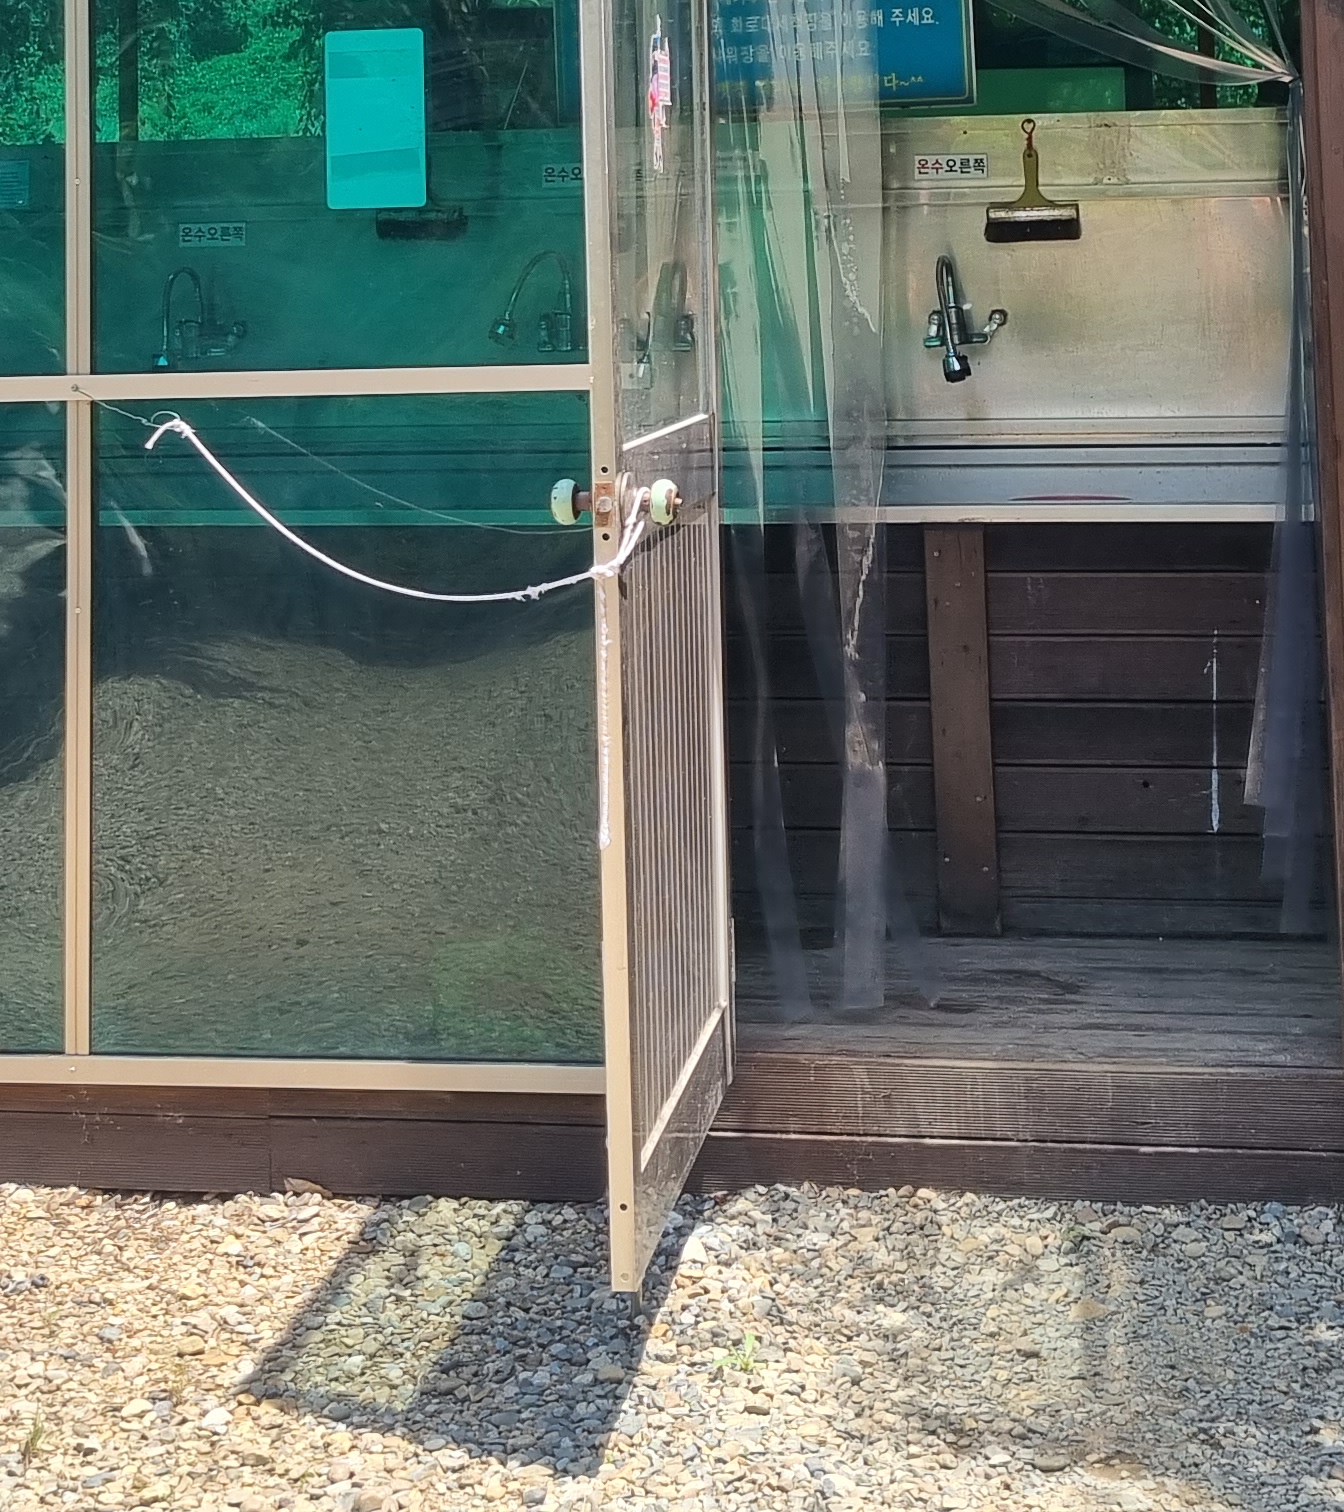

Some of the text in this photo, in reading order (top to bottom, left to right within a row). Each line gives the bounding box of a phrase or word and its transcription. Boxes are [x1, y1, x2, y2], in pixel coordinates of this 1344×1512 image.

[890, 6, 940, 26] 주세요.
[543, 166, 583, 183] 온수오
[916, 157, 986, 175] 온수오른쪽
[180, 226, 245, 243] 온수오른쪽
